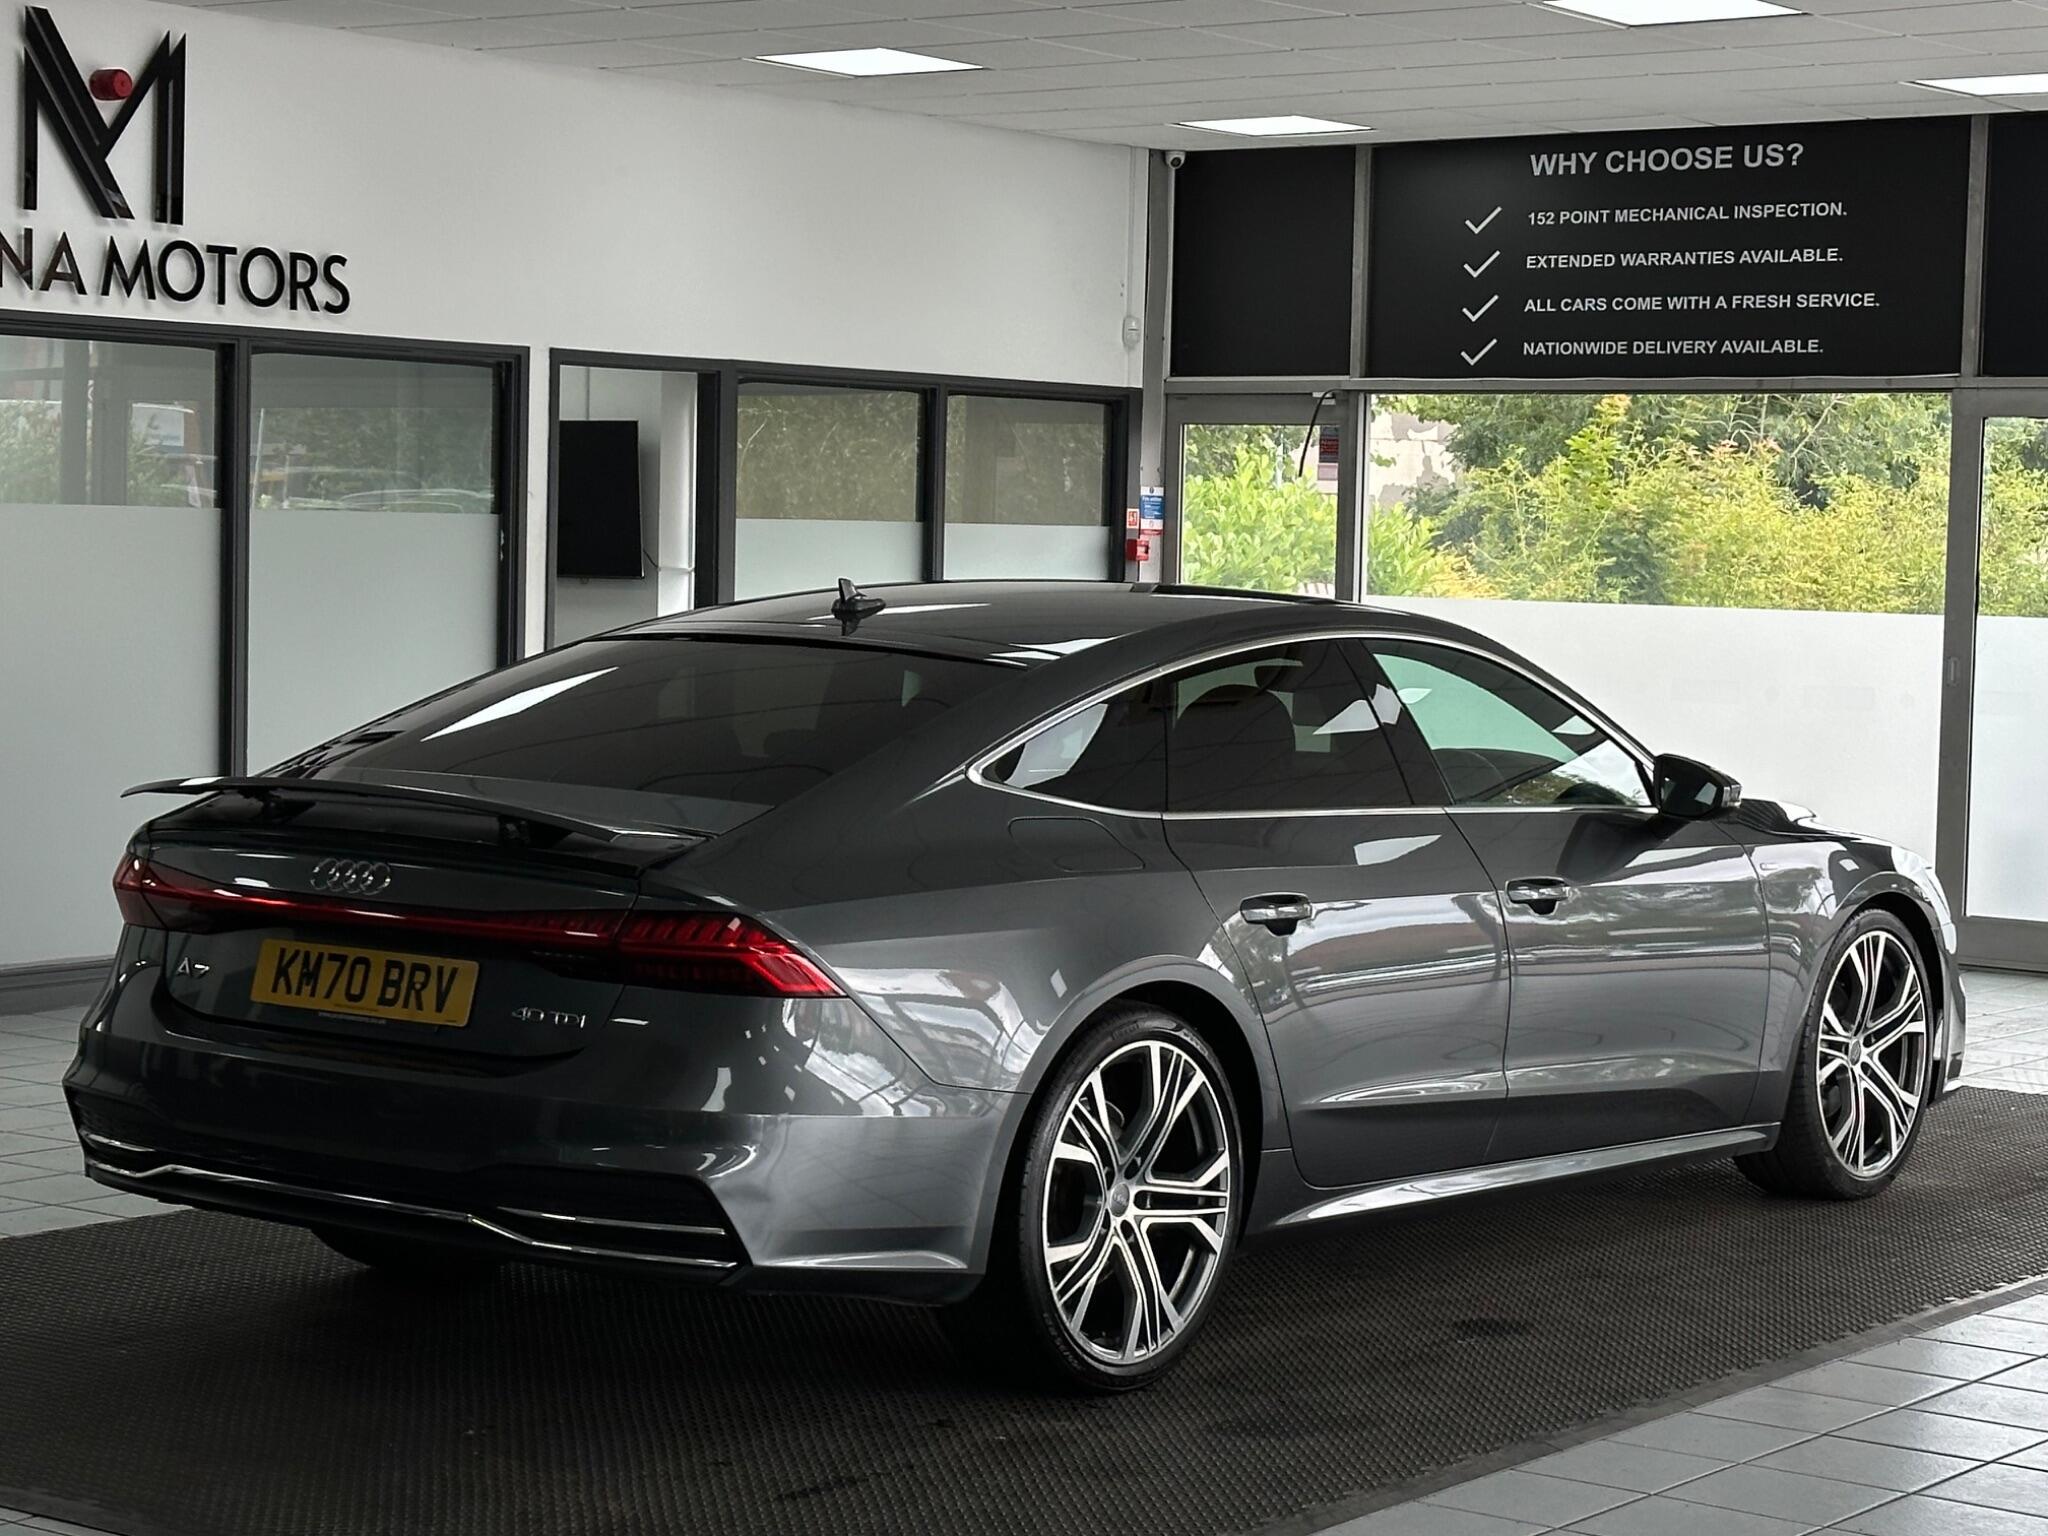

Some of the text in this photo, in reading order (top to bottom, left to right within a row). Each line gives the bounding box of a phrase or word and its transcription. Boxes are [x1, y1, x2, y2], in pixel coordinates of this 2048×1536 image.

[1531, 143, 1803, 176] WHY CHOOSE US?
[1528, 202, 1847, 225] 152 POINT MECHANICAL INSPECTION.
[1527, 248, 1843, 268] EXTENDED WARRANTIES AVAILABLE.
[100, 235, 351, 314] MOTORS
[1524, 293, 1879, 312] ALL CARS COME WITH A FRESH SERVICE.
[1524, 340, 1823, 355] NATIONWIDE DELIVERY AVAILABLE.
[177, 957, 210, 974] A7
[271, 947, 459, 1014] KM70 BRV
[549, 1010, 586, 1029] TDI
